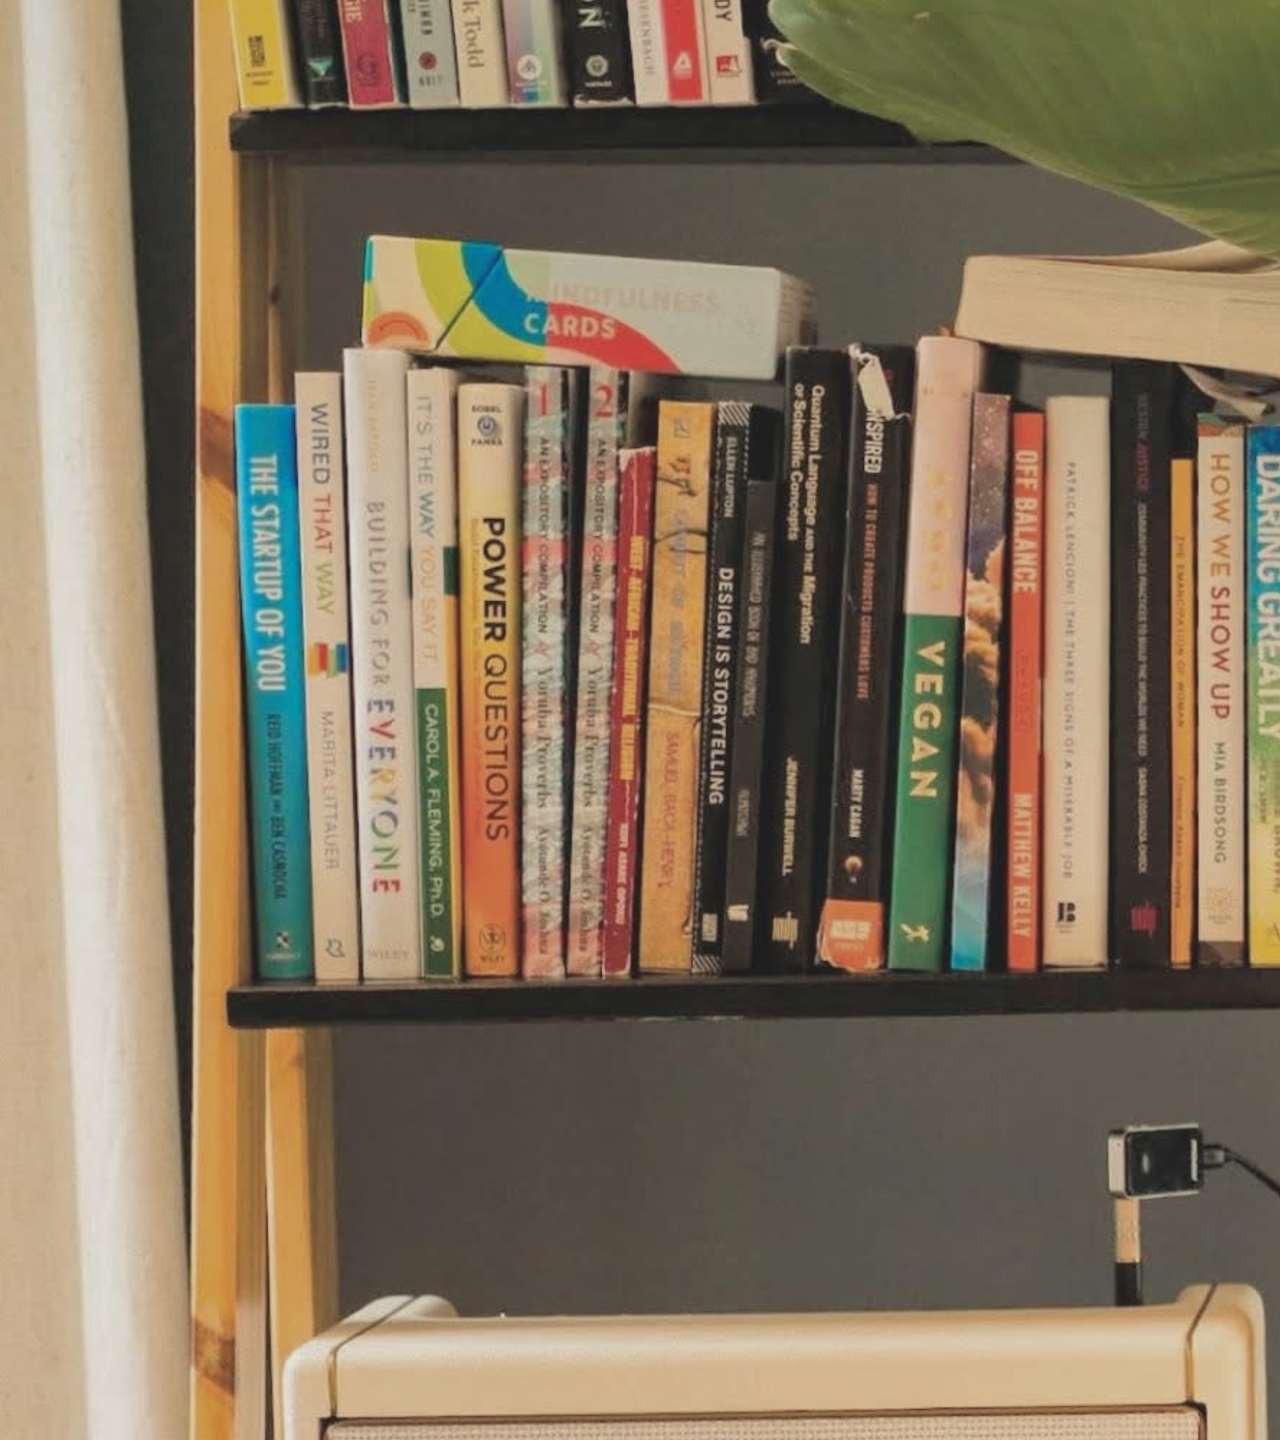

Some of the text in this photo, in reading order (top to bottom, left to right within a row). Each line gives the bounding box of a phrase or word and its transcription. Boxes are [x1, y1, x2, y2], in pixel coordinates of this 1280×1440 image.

[524, 313, 616, 340] CARDS
[248, 455, 286, 691] THE STARTUP OF YOU
[311, 403, 335, 616] WIRED THAT WAY
[724, 437, 736, 517] ELLEN LUPTON
[1012, 449, 1038, 594] OFF BALANCE
[483, 518, 508, 841] POWER QUESTIONS
[708, 568, 735, 805] DESIGN IS STORYTELLING
[1209, 454, 1230, 720] HOW WE SHOW UP
[366, 502, 401, 893] BUILDING FOR EVERYONE
[909, 640, 946, 798] VEGAN
[1214, 742, 1226, 863] MIA BIRDSONG
